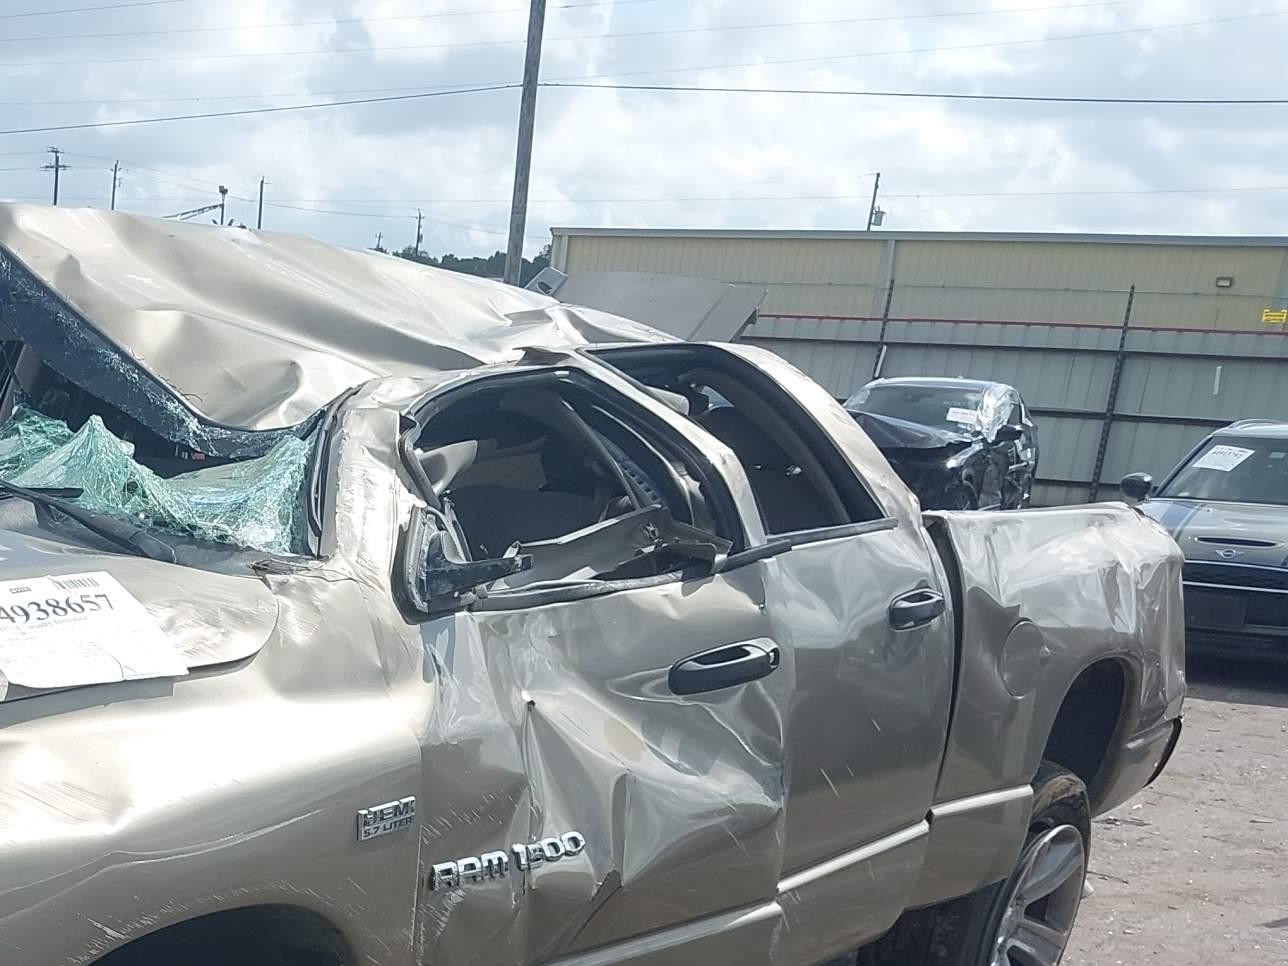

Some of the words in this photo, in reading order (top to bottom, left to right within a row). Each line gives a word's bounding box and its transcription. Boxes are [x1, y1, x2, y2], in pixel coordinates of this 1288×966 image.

[358, 796, 416, 825] HEMI
[363, 825, 380, 839] 5.7
[383, 815, 413, 832] LITER
[430, 850, 509, 891] RAM
